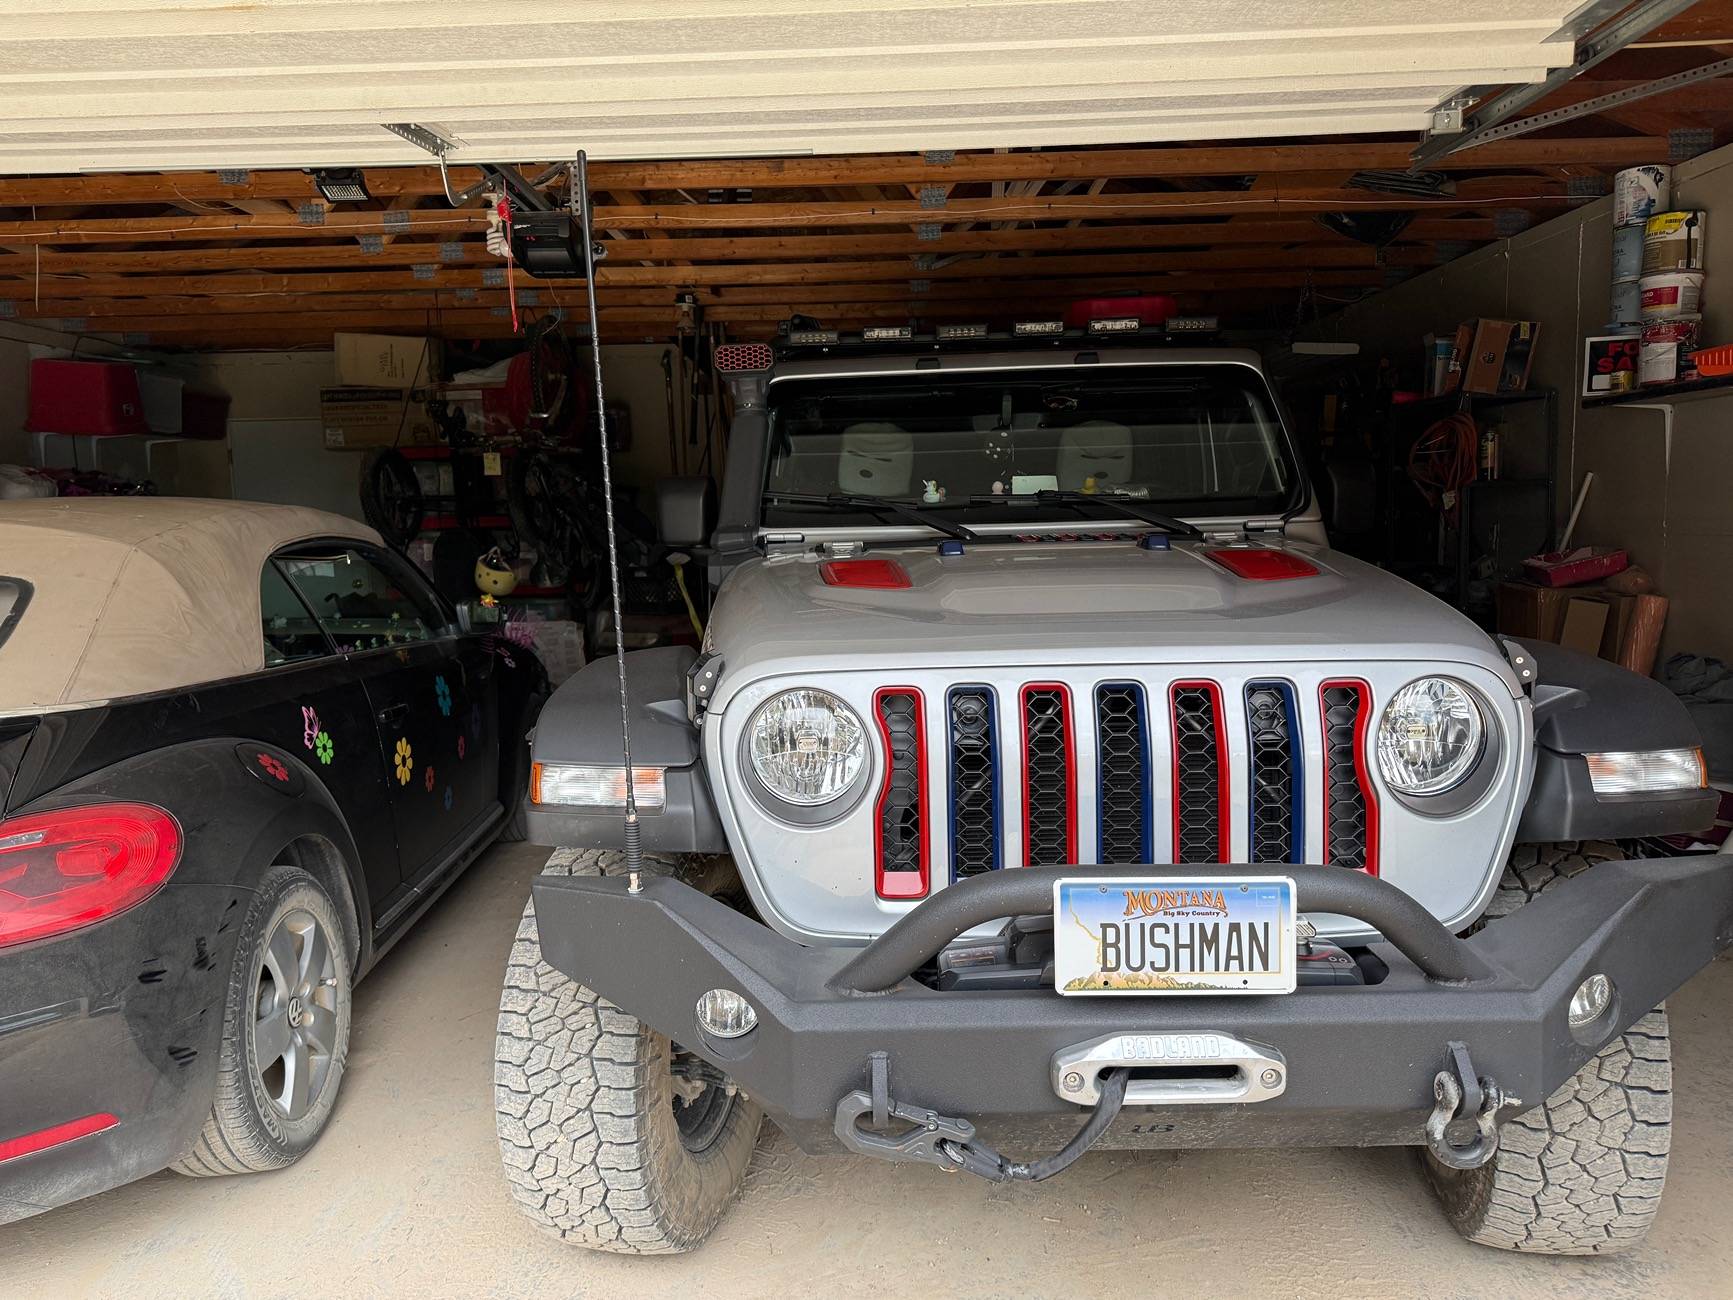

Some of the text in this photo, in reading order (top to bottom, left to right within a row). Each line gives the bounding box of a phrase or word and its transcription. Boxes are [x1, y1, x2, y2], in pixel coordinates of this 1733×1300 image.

[1608, 341, 1639, 357] FO
[1123, 889, 1228, 917] MONTANA
[1163, 910, 1221, 918] Big Sky Country
[1100, 921, 1270, 973] BUSHMAN
[1121, 1035, 1221, 1059] BADLAND
